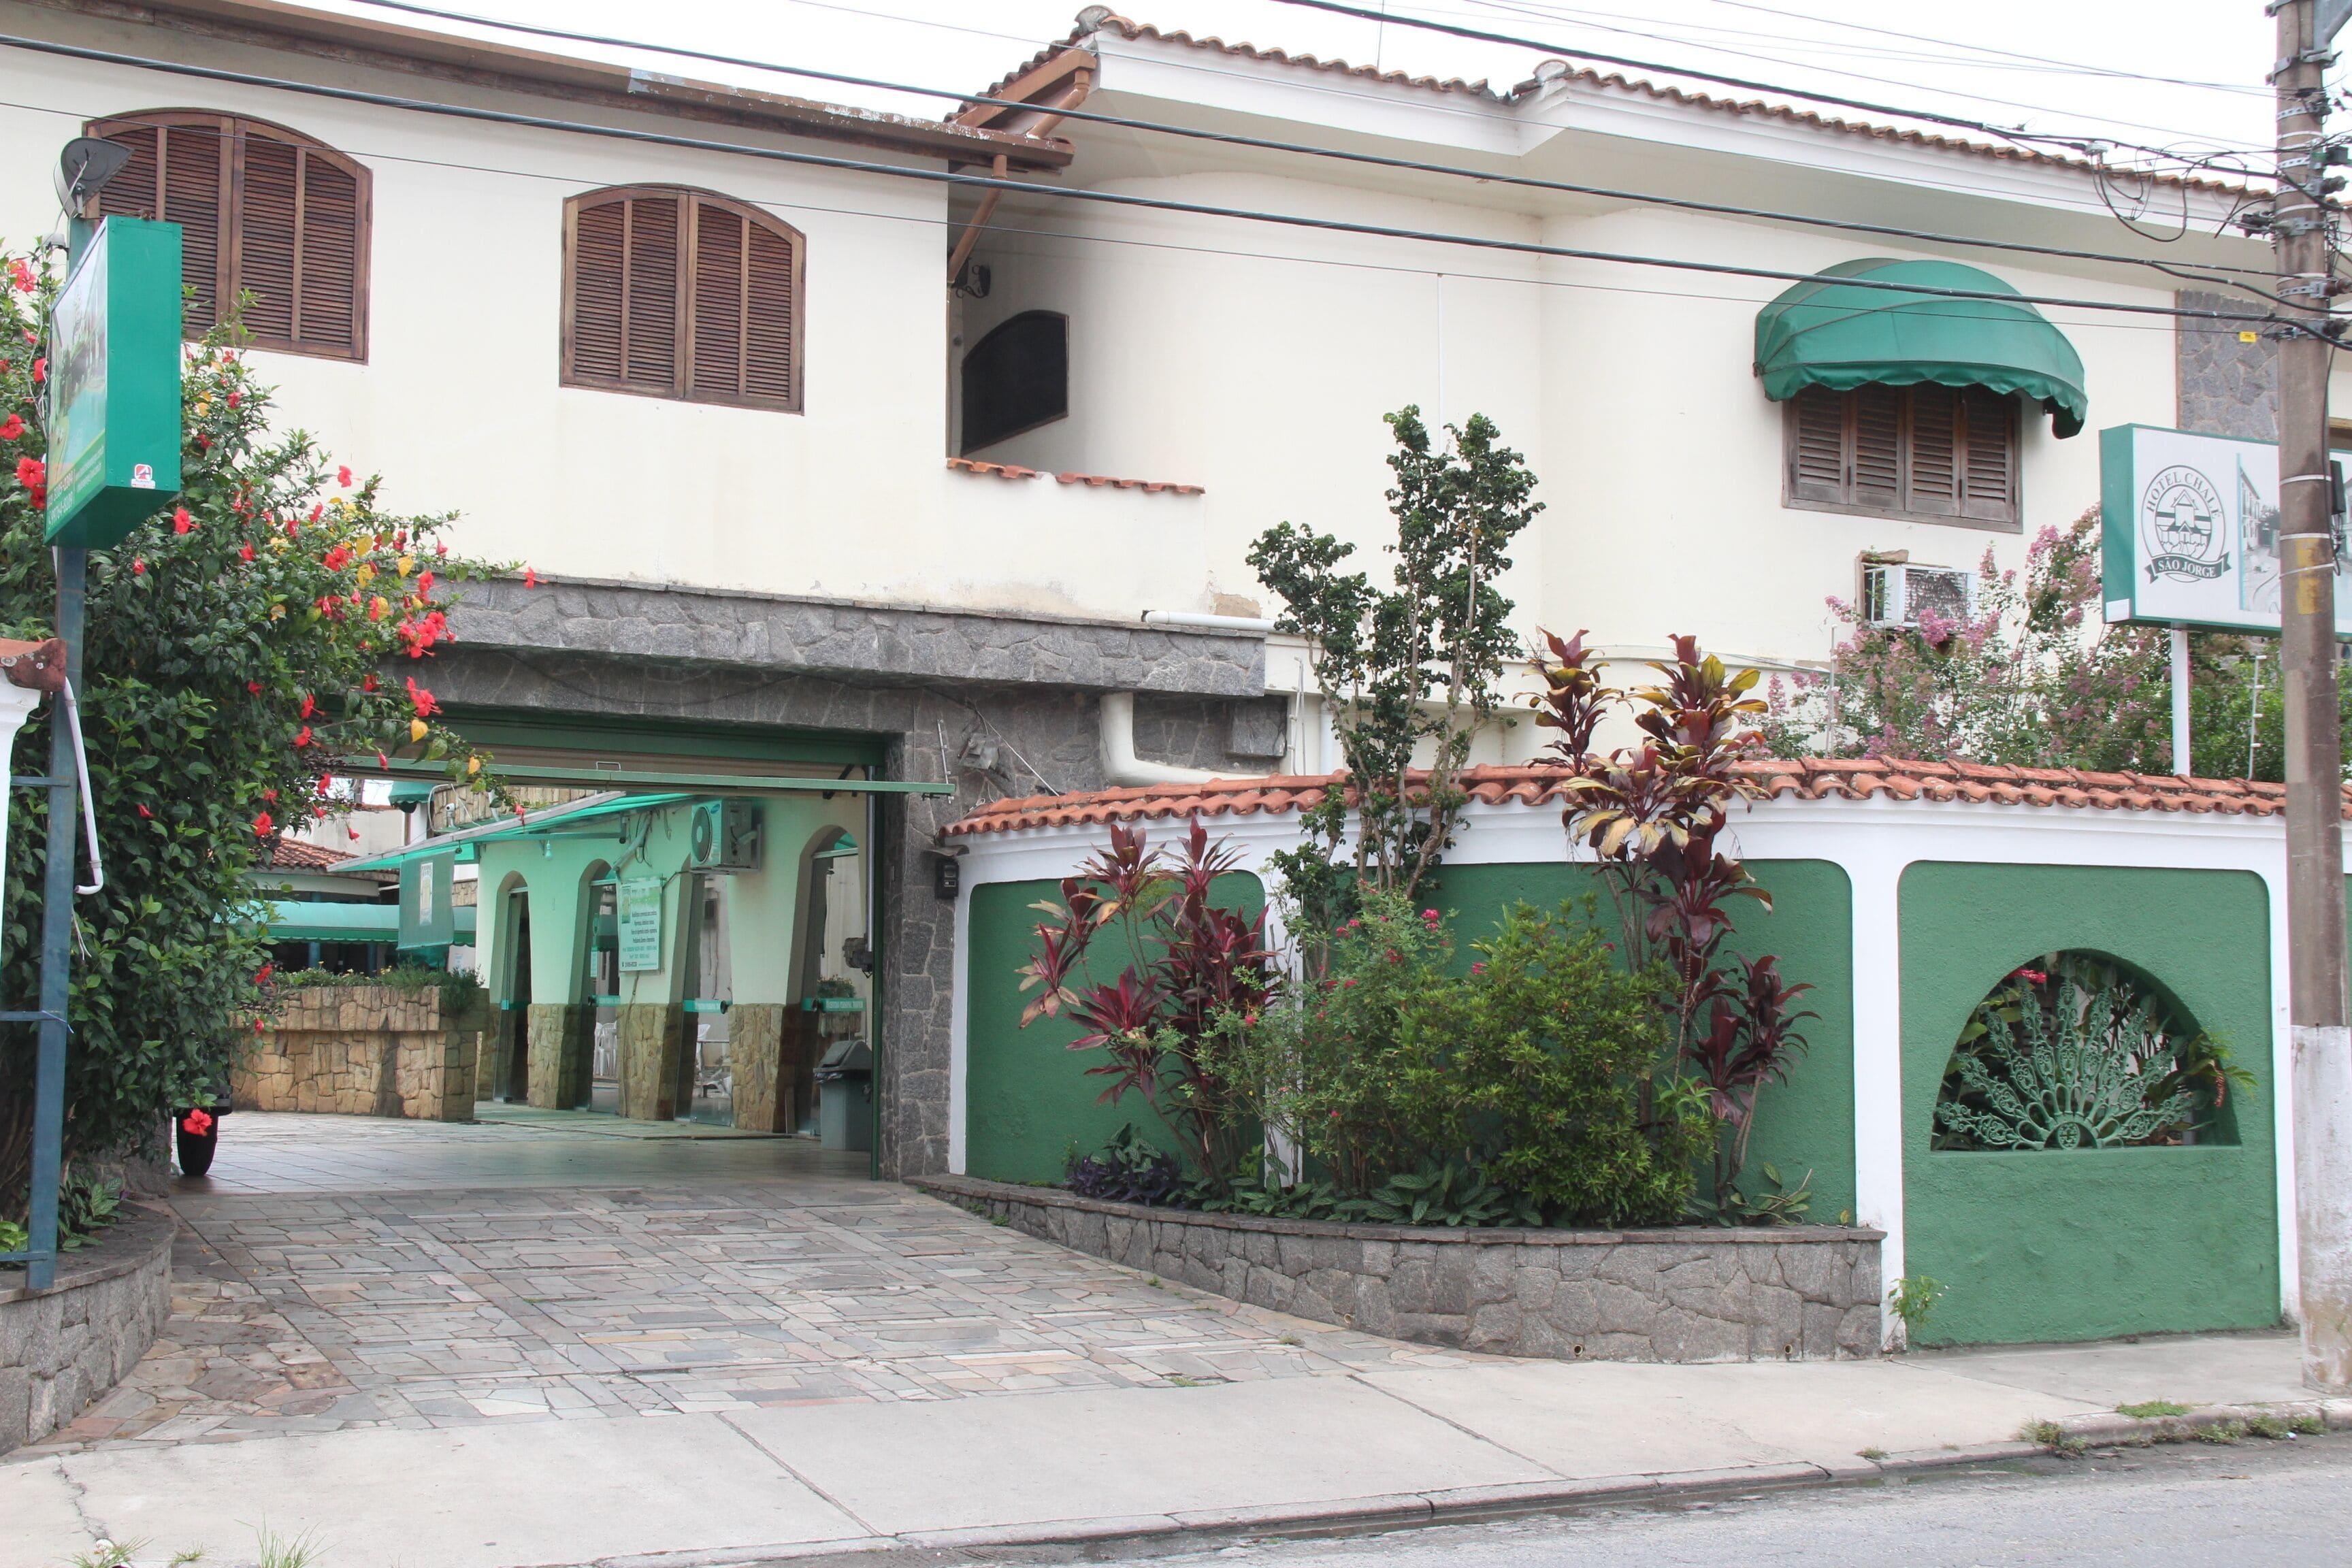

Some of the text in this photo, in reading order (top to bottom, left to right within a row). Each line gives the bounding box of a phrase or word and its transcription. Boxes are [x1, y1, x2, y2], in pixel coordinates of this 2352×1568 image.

[2146, 471, 2182, 513] HOTEL
[2157, 557, 2217, 578] SÃO JORGE
